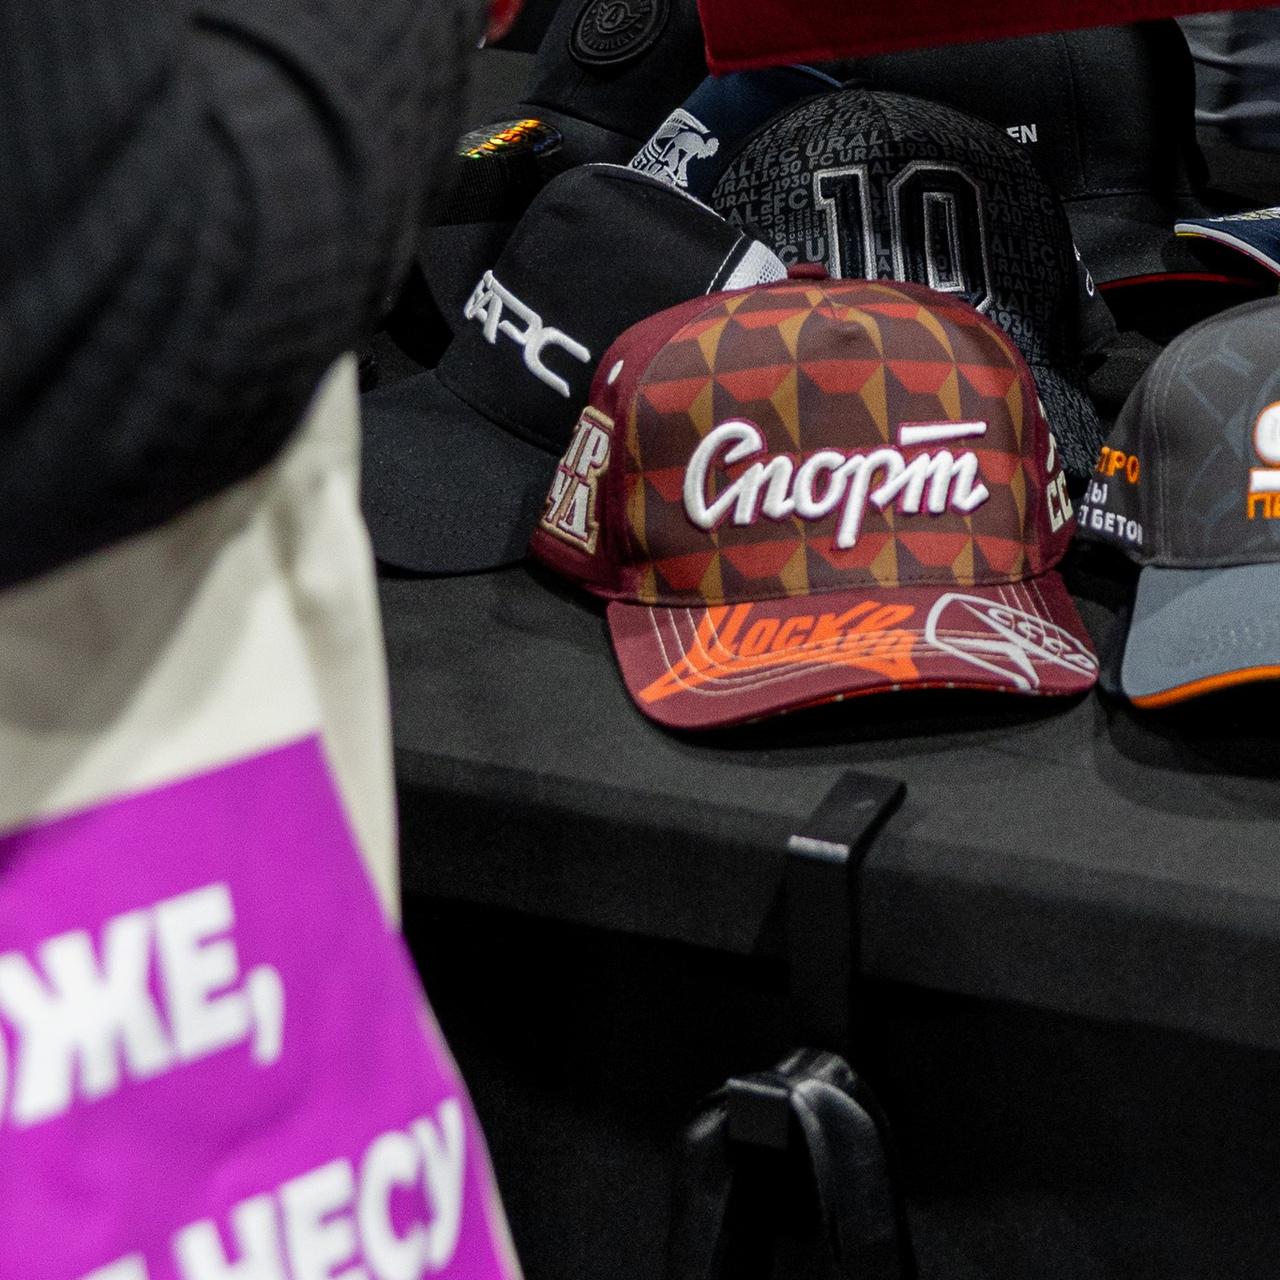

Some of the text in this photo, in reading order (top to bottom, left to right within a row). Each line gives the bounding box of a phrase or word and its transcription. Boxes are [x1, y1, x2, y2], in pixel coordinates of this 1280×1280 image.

[812, 158, 994, 313] 10
[683, 421, 990, 549] Спорт
[0, 879, 286, 1129] ЖЕ,
